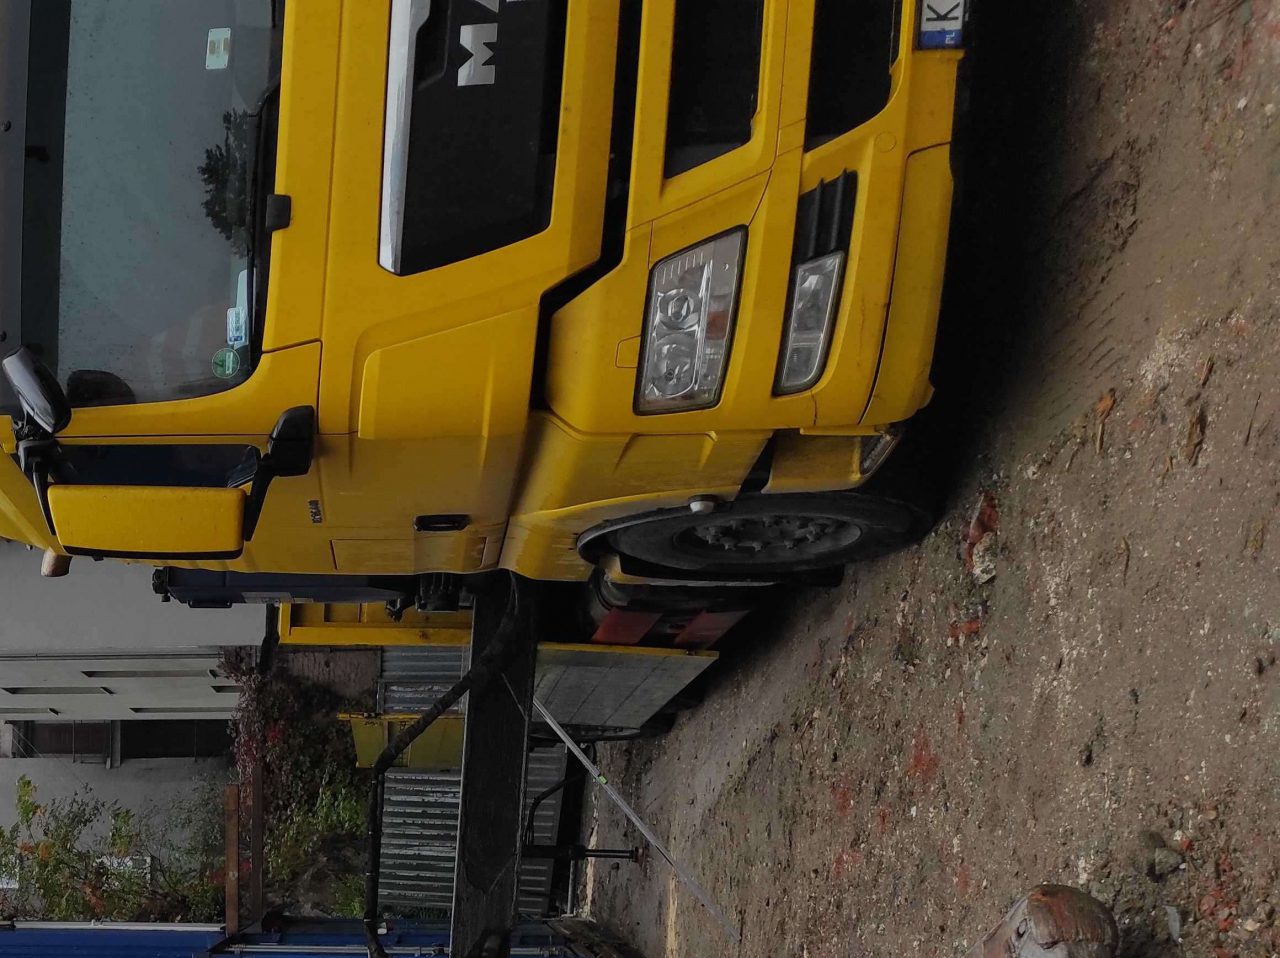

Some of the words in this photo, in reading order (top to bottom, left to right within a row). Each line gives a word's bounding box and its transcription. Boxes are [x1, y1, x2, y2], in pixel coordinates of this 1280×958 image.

[925, 2, 961, 22] K
[456, 0, 499, 87] M
[946, 33, 955, 44] PL
